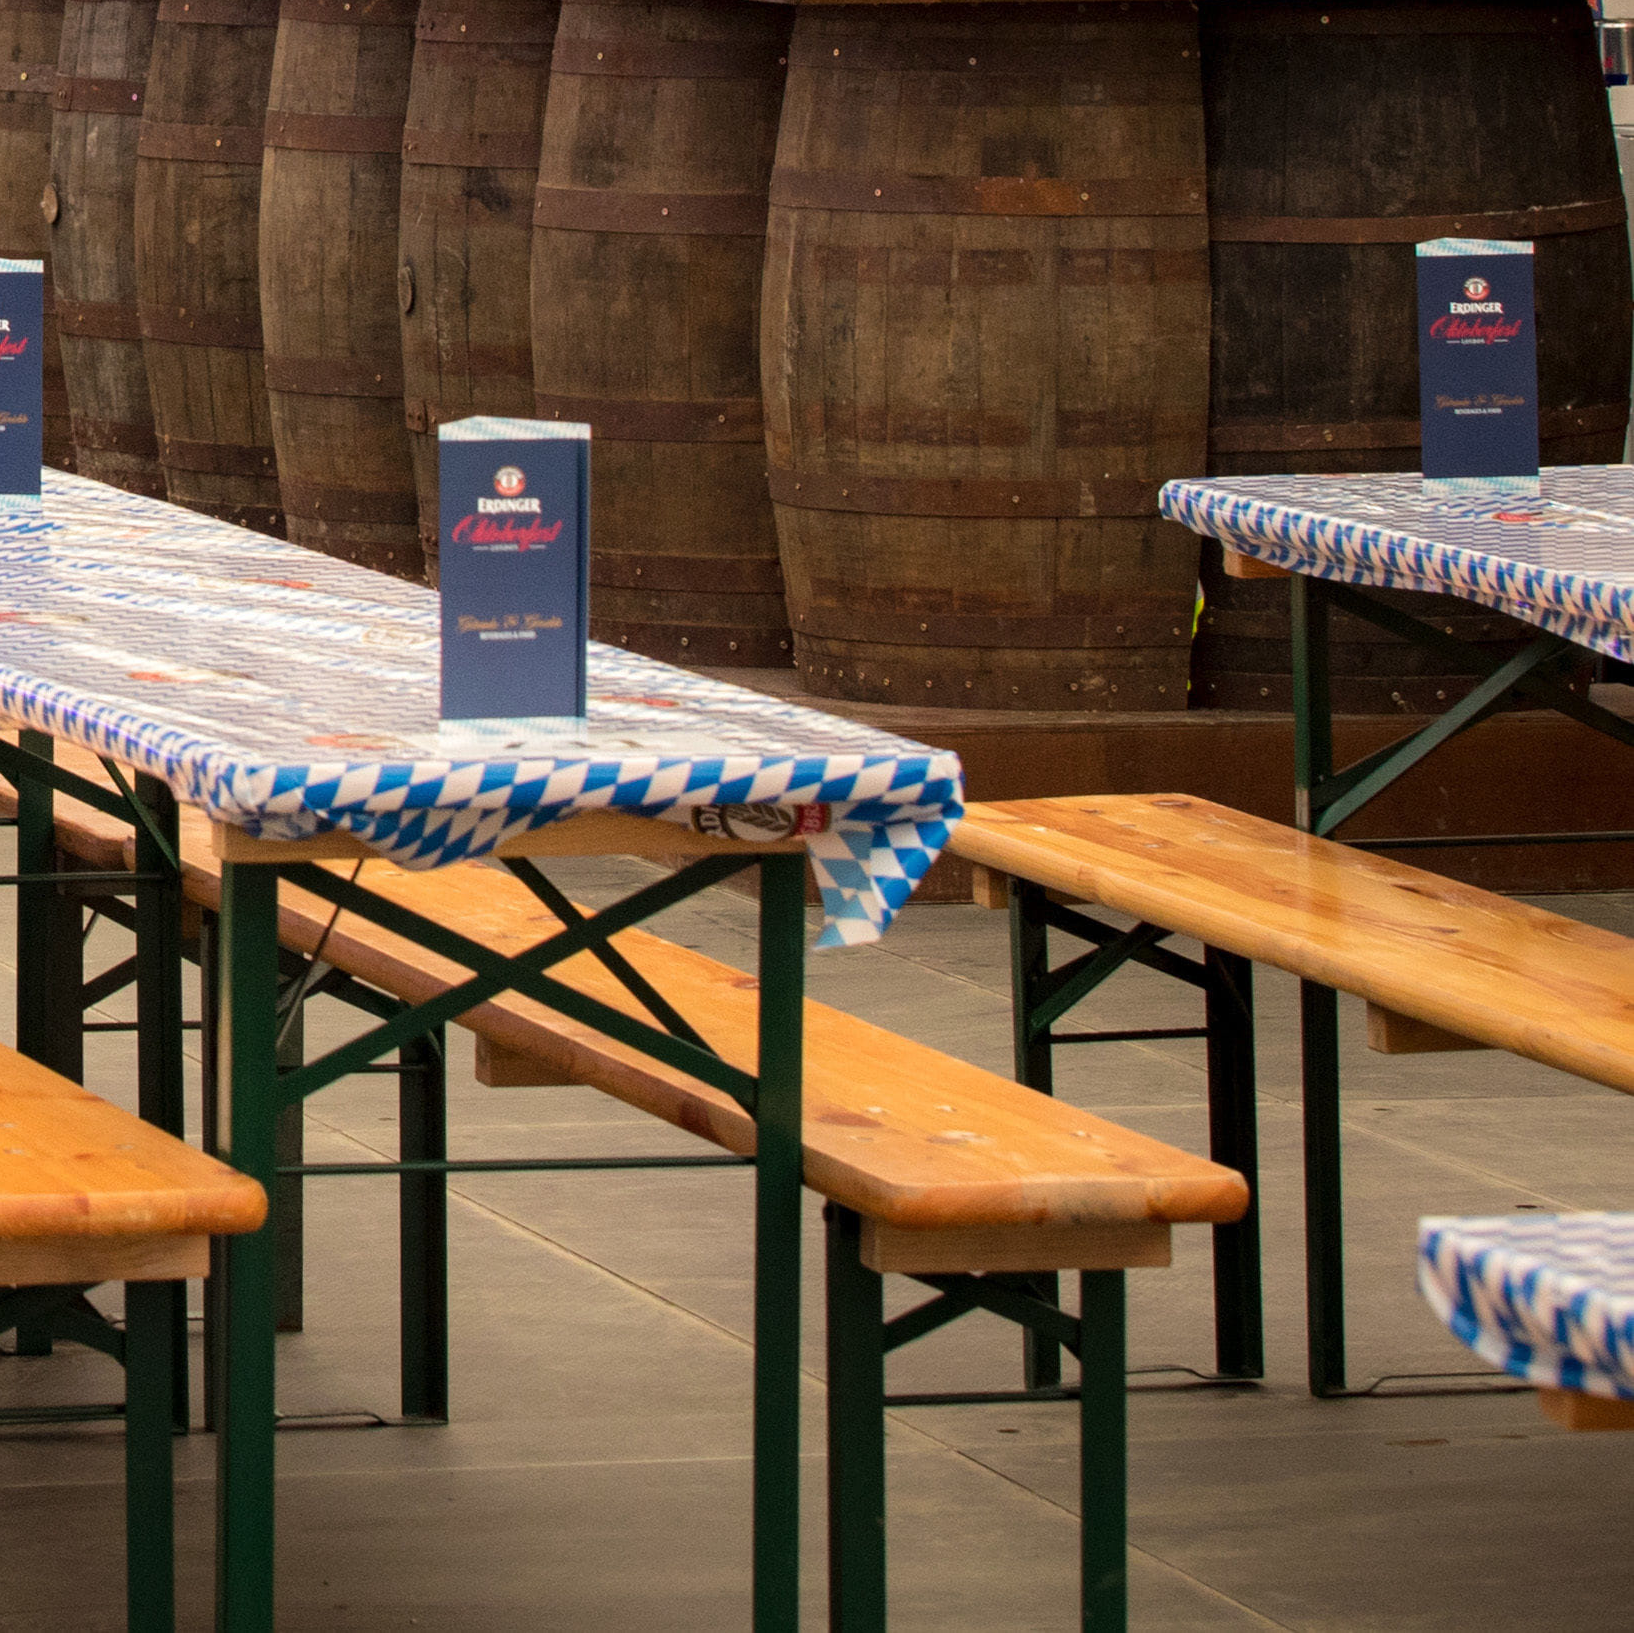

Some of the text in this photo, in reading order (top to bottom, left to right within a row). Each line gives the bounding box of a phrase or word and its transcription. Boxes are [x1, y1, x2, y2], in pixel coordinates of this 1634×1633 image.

[1450, 302, 1504, 315] ERDINGER
[1429, 315, 1523, 345] Oktoberfest
[477, 497, 542, 513] ERDINGER
